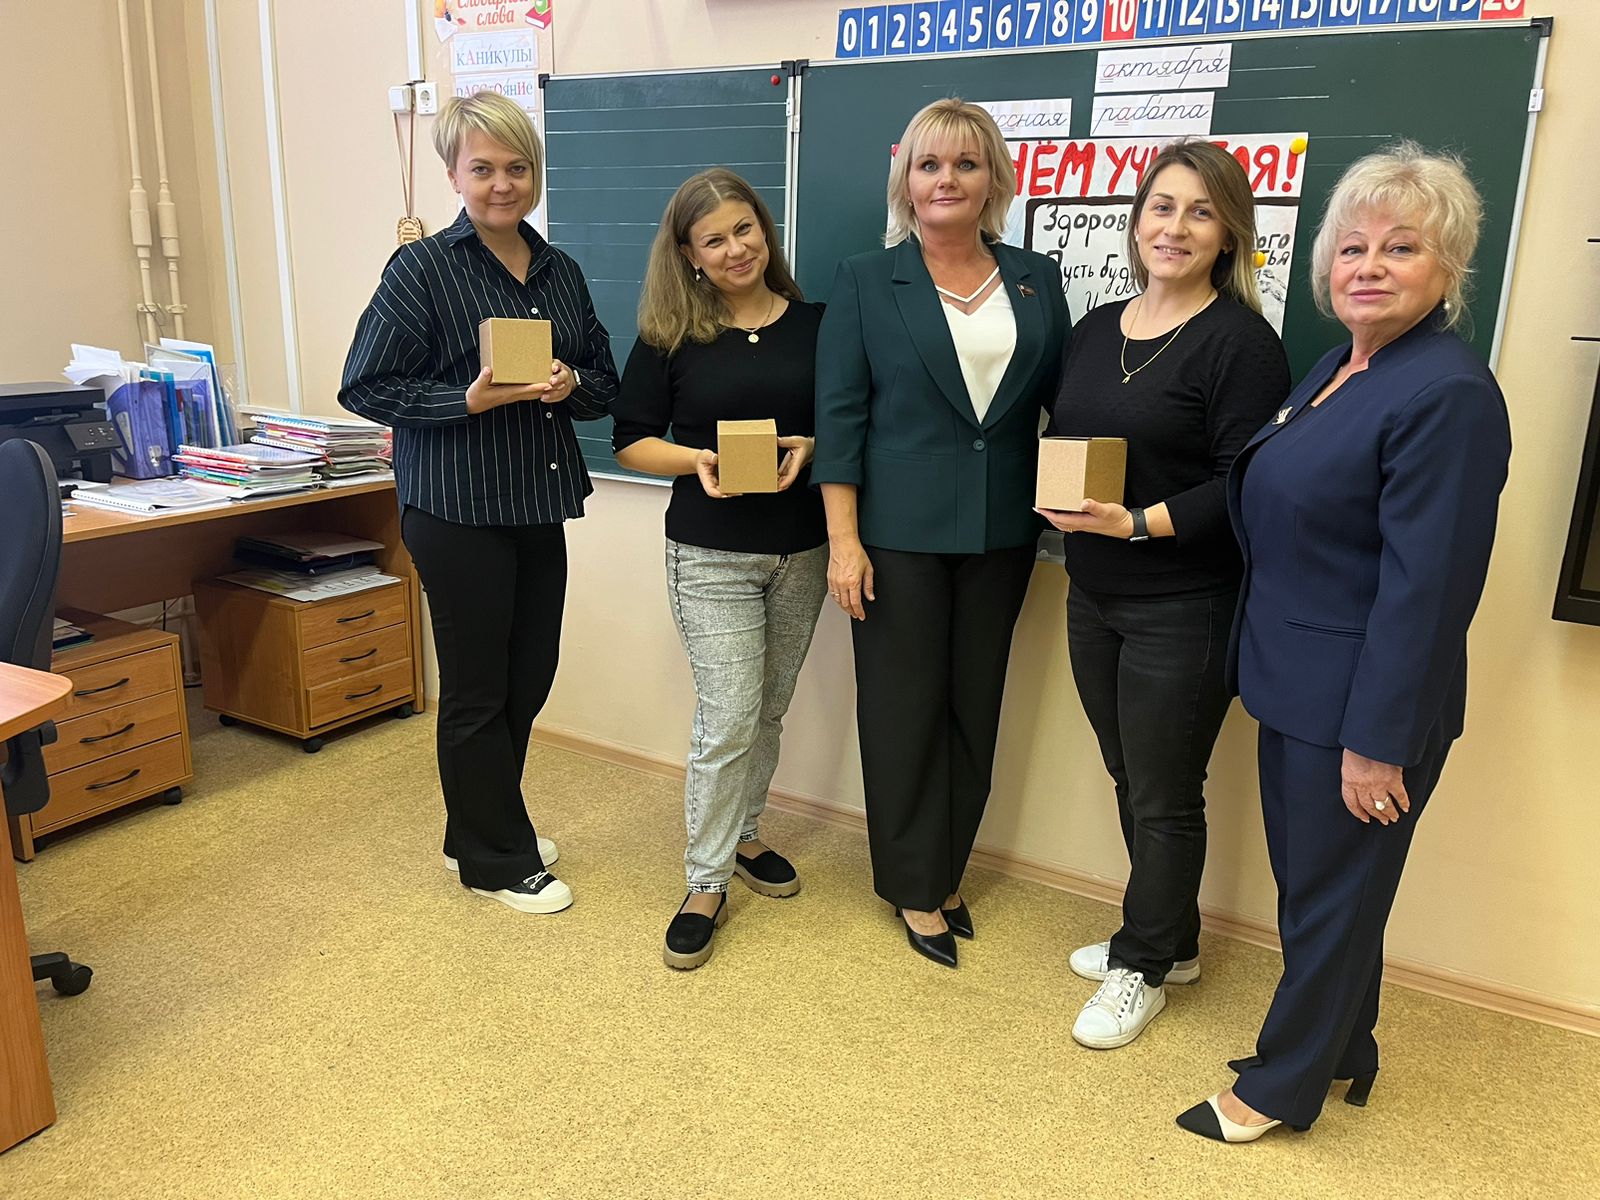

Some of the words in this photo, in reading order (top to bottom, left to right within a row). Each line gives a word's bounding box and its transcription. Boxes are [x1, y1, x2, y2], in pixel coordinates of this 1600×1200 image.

[476, 5, 515, 26] слова
[842, 17, 857, 51] 0
[868, 15, 879, 49] 1
[891, 13, 906, 48] 2
[917, 11, 931, 47] 3
[942, 8, 957, 44] 4
[967, 6, 983, 43] 5
[995, 4, 1012, 42] 6
[1025, 2, 1041, 40] 7
[1052, 0, 1069, 37] 8
[1081, 0, 1098, 35] 9
[1110, 0, 1135, 32] 10
[1143, 0, 1168, 29] 11
[1178, 0, 1205, 26] 12
[1043, 203, 1127, 248] Здоров
[1257, 233, 1290, 249] ого
